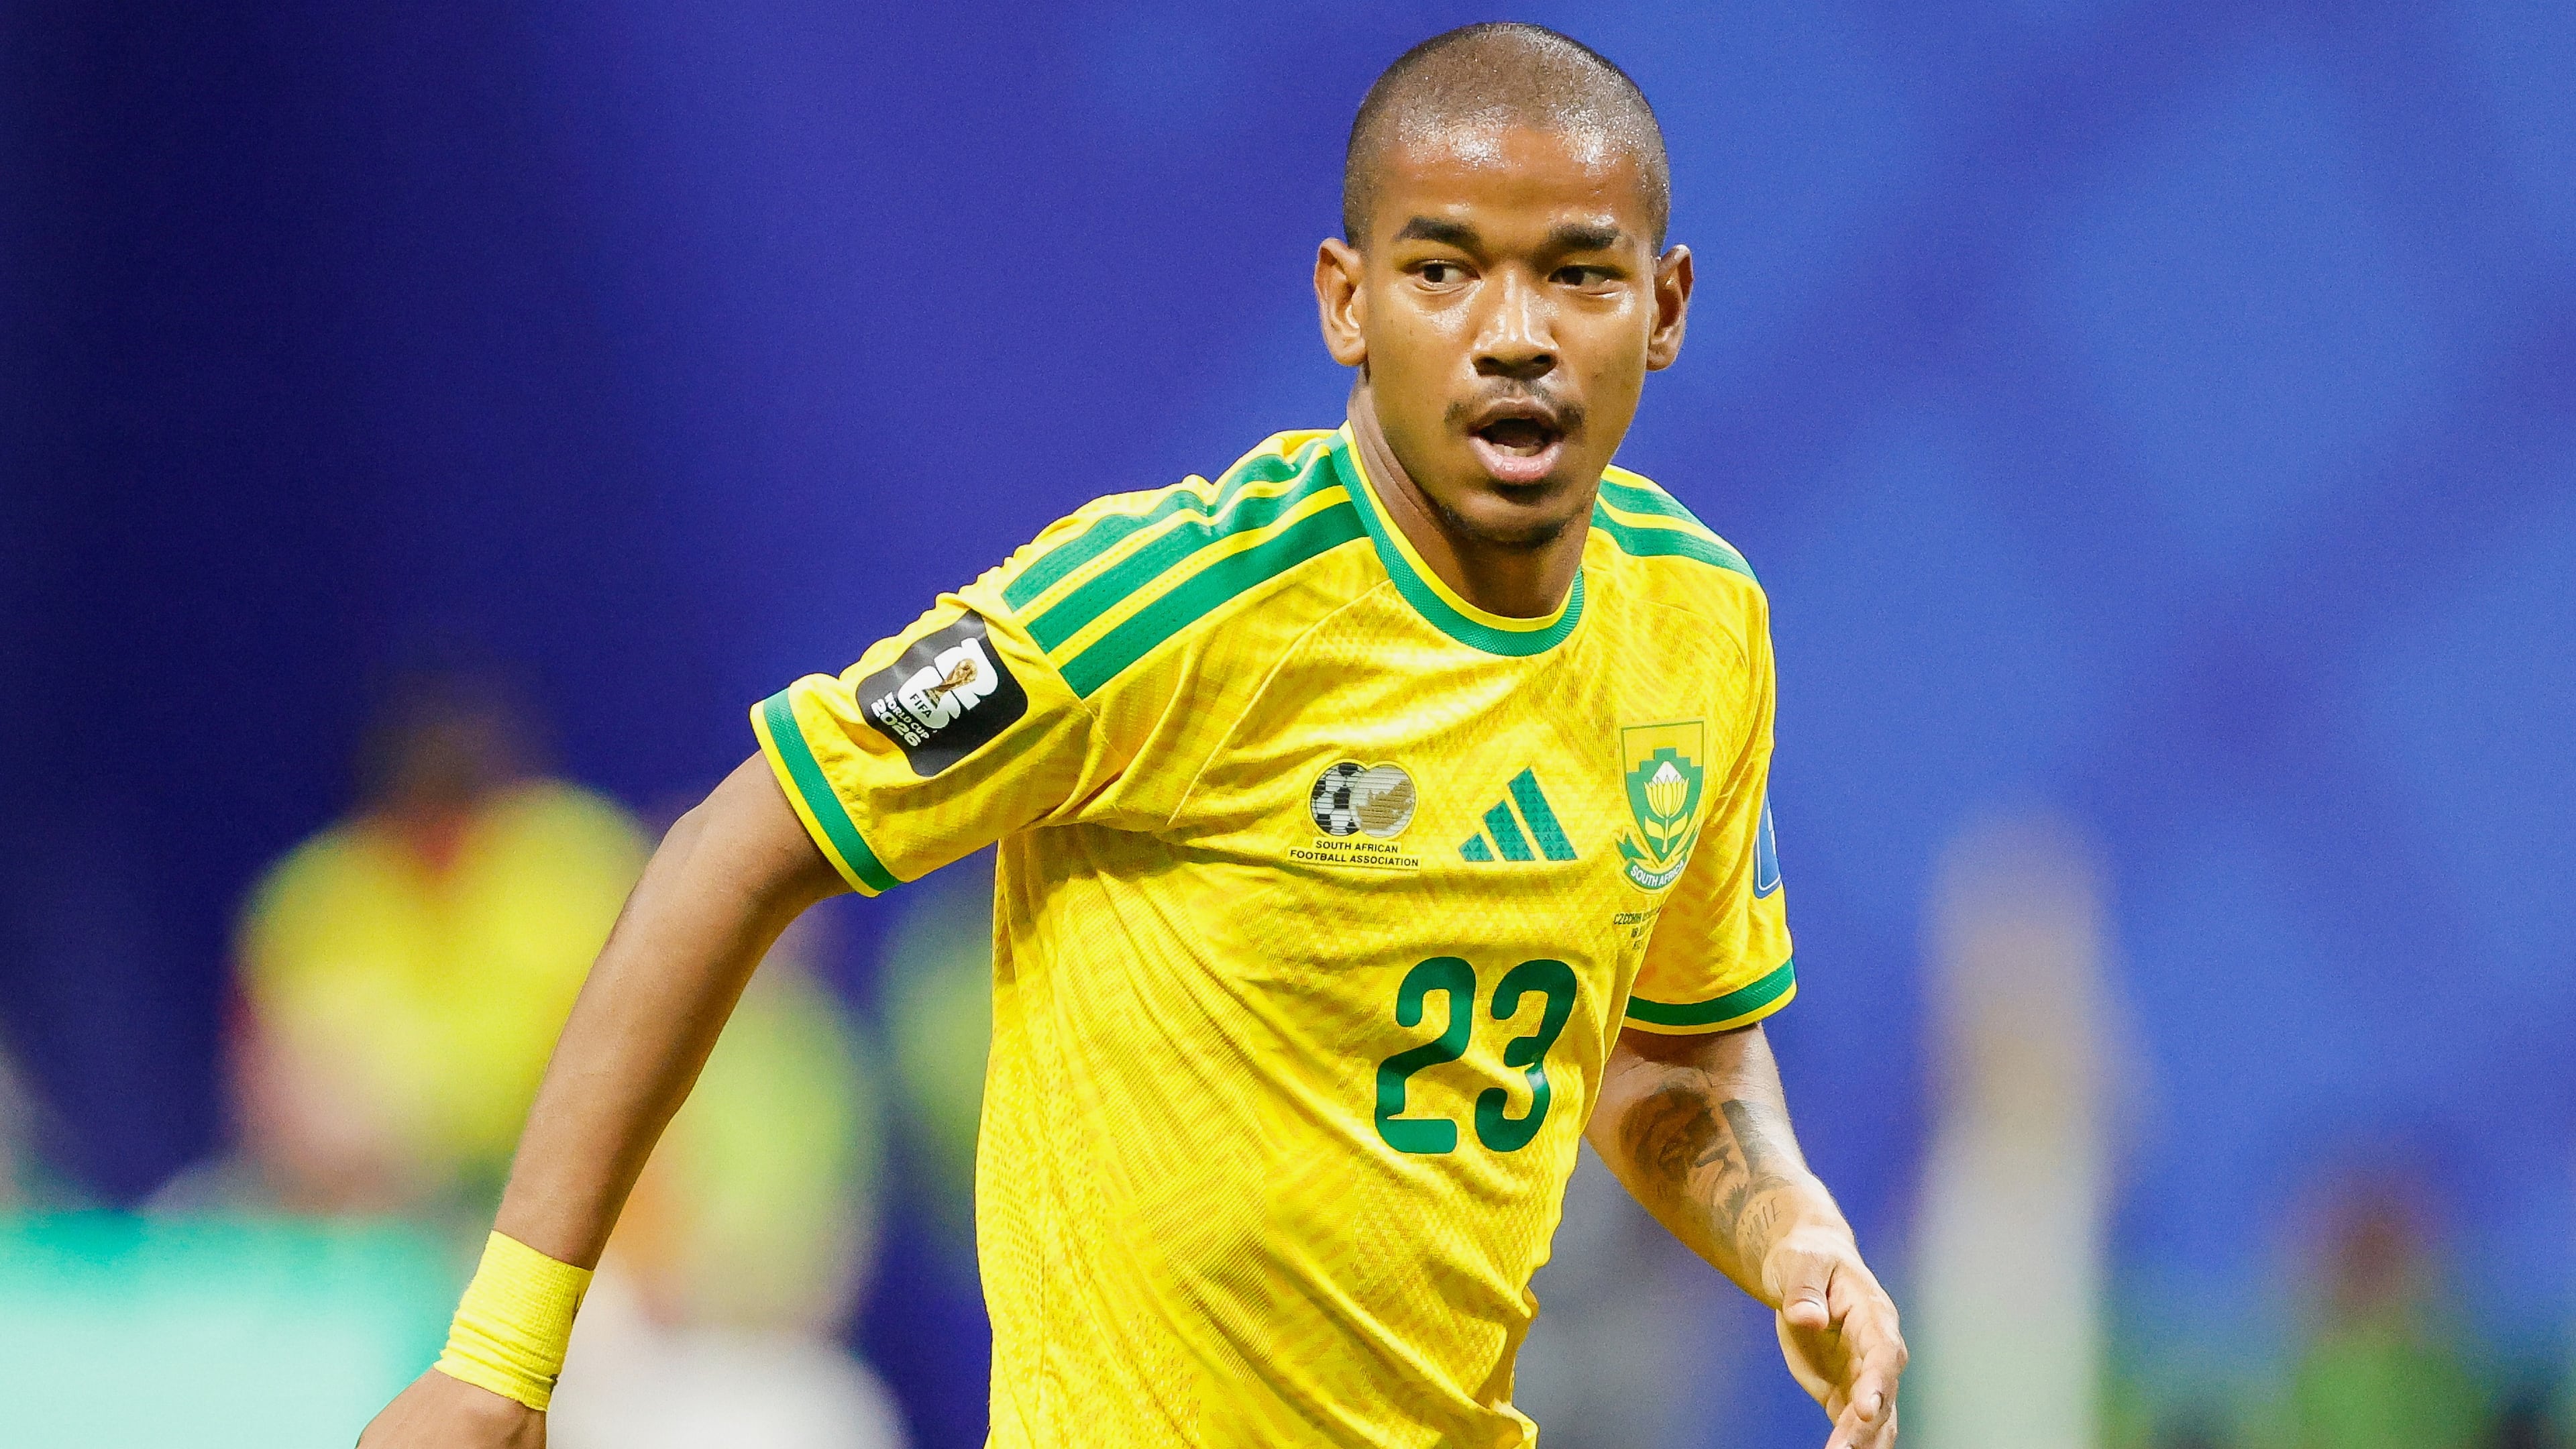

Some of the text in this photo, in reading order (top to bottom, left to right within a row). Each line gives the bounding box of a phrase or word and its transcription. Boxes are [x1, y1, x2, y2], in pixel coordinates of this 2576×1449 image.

[910, 693, 932, 718] FIFA
[871, 698, 922, 747] 2026
[910, 722, 930, 739] CUP
[1290, 849, 1419, 867] FOOTBALL ASSOCIATION
[1316, 841, 1398, 853] SOUTH AFRICAN
[1630, 859, 1684, 887] SOUTH AFRICA
[1375, 956, 1577, 1154] 23
